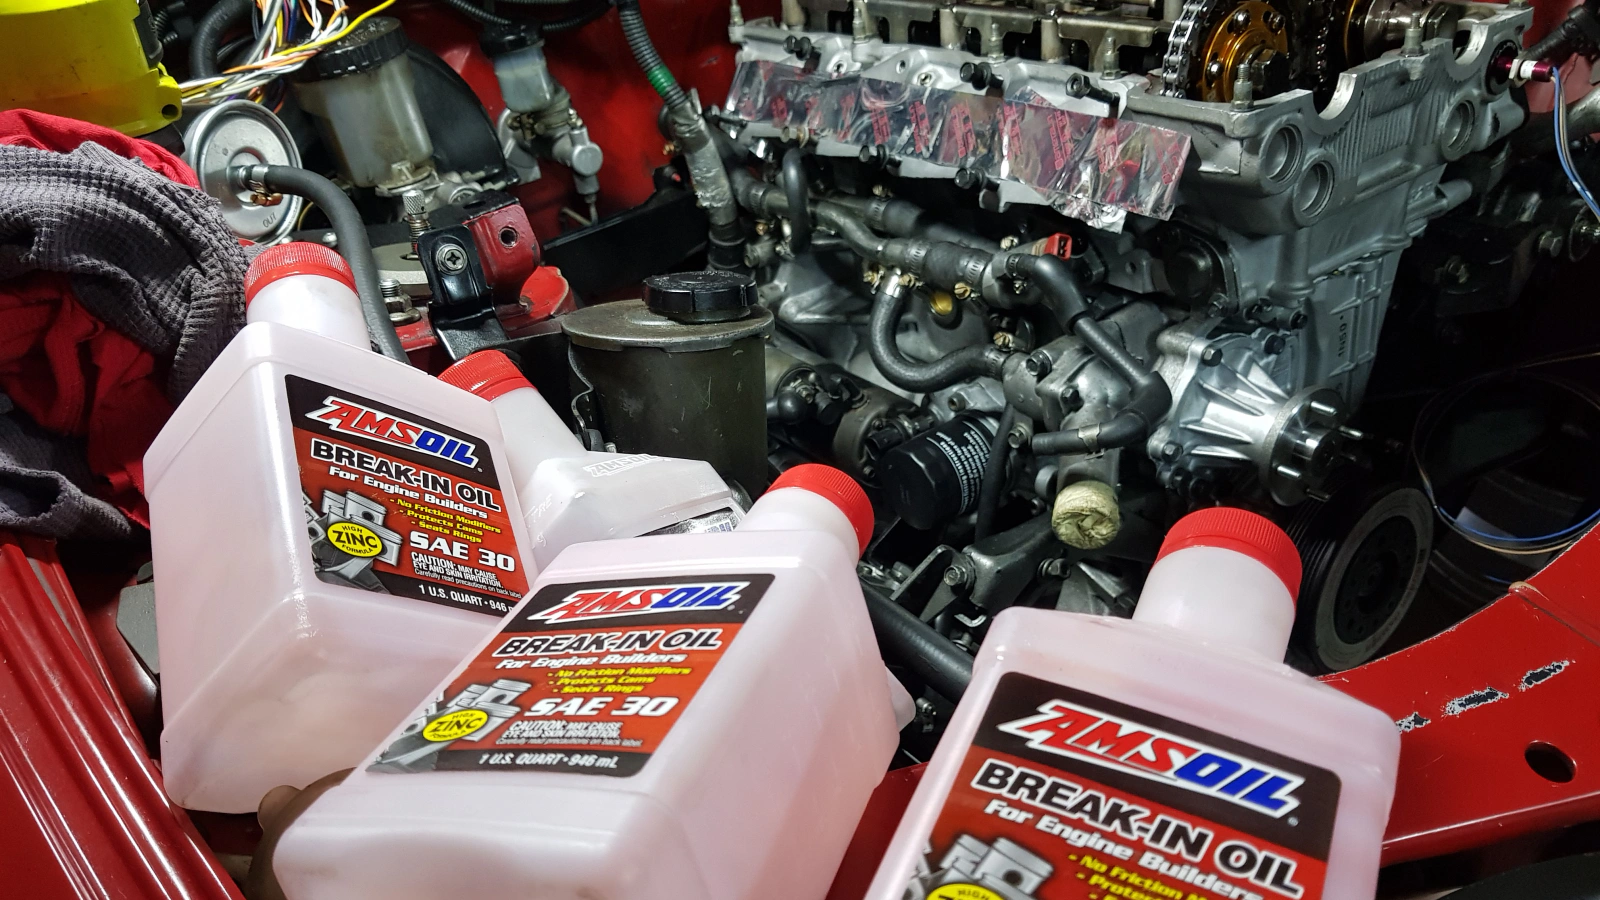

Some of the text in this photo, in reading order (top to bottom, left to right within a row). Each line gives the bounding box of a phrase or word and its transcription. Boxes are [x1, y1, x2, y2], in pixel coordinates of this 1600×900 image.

[263, 212, 276, 228] OUT
[305, 396, 478, 468] AMSOIL
[311, 438, 501, 512] BREAK-IN OIL
[582, 454, 660, 477] AMSOIL
[330, 466, 488, 519] For Engine Builders
[398, 499, 501, 533] No Friction Modifiers
[407, 510, 483, 536] Protects Cams
[332, 530, 378, 548] ZINC
[419, 521, 482, 543] Seats Rings
[342, 544, 373, 554] FORMULA
[409, 531, 515, 572] SAE 30
[411, 552, 497, 580] CAUTION: MAY CAUSE
[413, 561, 428, 570] EYE
[429, 564, 444, 574] AND
[446, 568, 462, 578] SKIN
[415, 568, 440, 580] Carefully
[456, 578, 487, 591] precautions
[419, 584, 425, 594] 1
[429, 586, 448, 599] U.S.
[450, 591, 482, 606] QUART
[490, 600, 507, 612] 946
[527, 580, 750, 624] AMSOIL
[492, 628, 724, 657] BREAK-IN OIL
[496, 652, 688, 670] For Engine Builders
[576, 668, 625, 677] Friction
[628, 667, 692, 675] Modifiers
[556, 677, 615, 685] Protects
[603, 685, 643, 693] Rings
[524, 697, 679, 716] SAE 30
[427, 718, 483, 733] ZINC
[509, 720, 624, 731] CAUTION: MAY CAUSE
[479, 752, 619, 769] 1 U.S. QUART 946 mL
[997, 698, 1305, 819] AMSOIL
[970, 758, 1304, 900] BREAK-IN OIL
[983, 799, 1266, 900] For Engine Builders
[1080, 854, 1183, 900] No Friction
